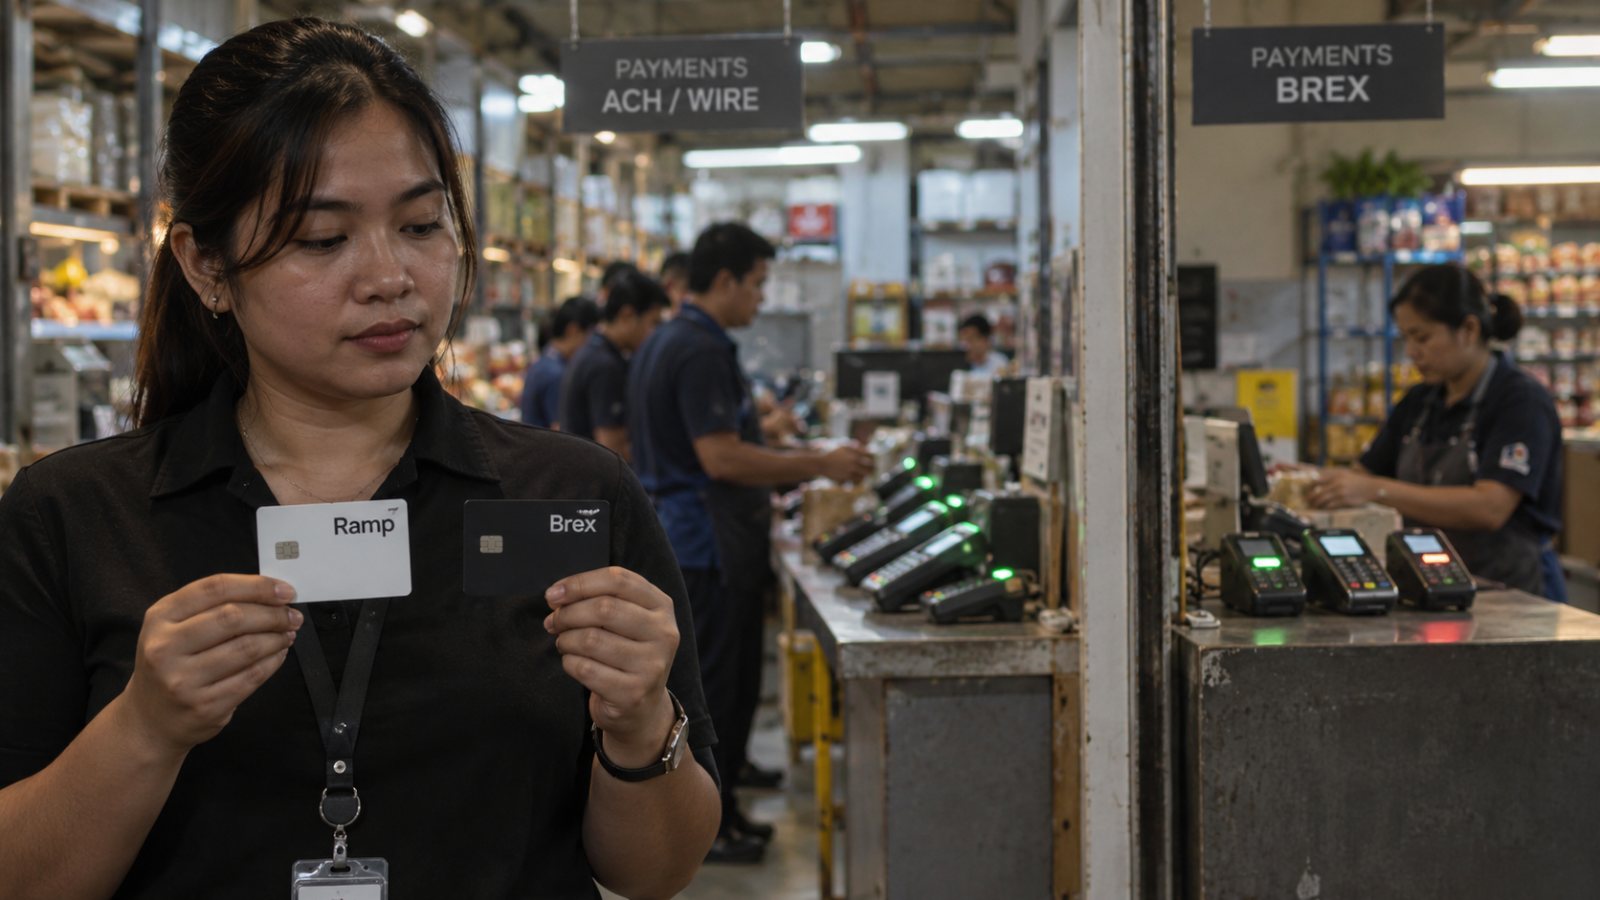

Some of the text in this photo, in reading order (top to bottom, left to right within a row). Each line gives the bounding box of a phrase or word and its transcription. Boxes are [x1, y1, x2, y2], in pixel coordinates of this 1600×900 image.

[1252, 44, 1393, 68] PAYMENTS
[616, 57, 748, 79] PAYMENTS
[1277, 75, 1370, 103] BREX
[602, 87, 759, 115] ACH / WIRE
[334, 517, 395, 538] Ramp
[550, 514, 597, 533] Brex
